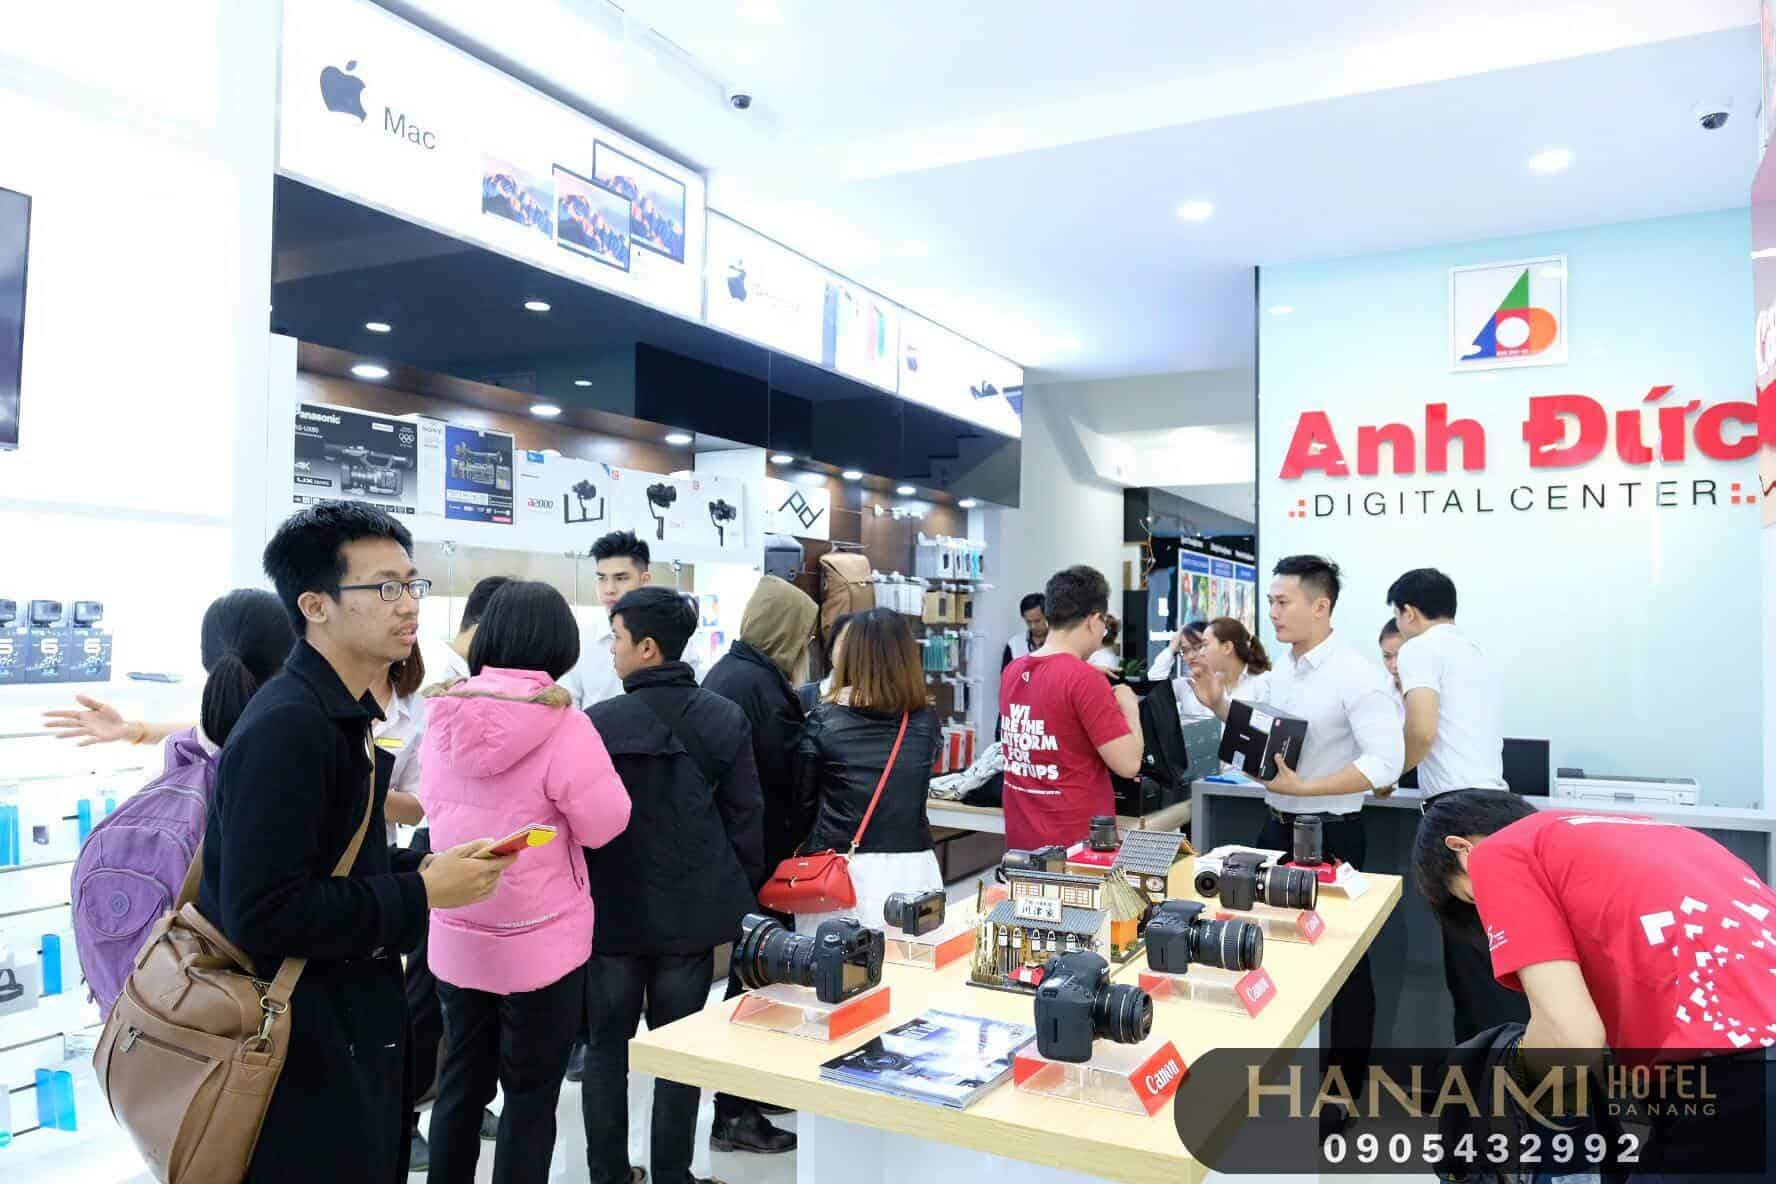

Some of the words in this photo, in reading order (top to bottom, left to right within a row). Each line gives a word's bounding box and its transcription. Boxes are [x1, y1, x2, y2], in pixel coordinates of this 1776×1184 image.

[384, 106, 436, 150] Mac
[1279, 402, 1487, 479] Anh
[1522, 385, 1760, 469] Đức
[1314, 489, 1495, 518] DIGITAL
[1510, 479, 1718, 512] CENTER
[1020, 720, 1045, 735] THE
[1145, 1059, 1180, 1095] Canon
